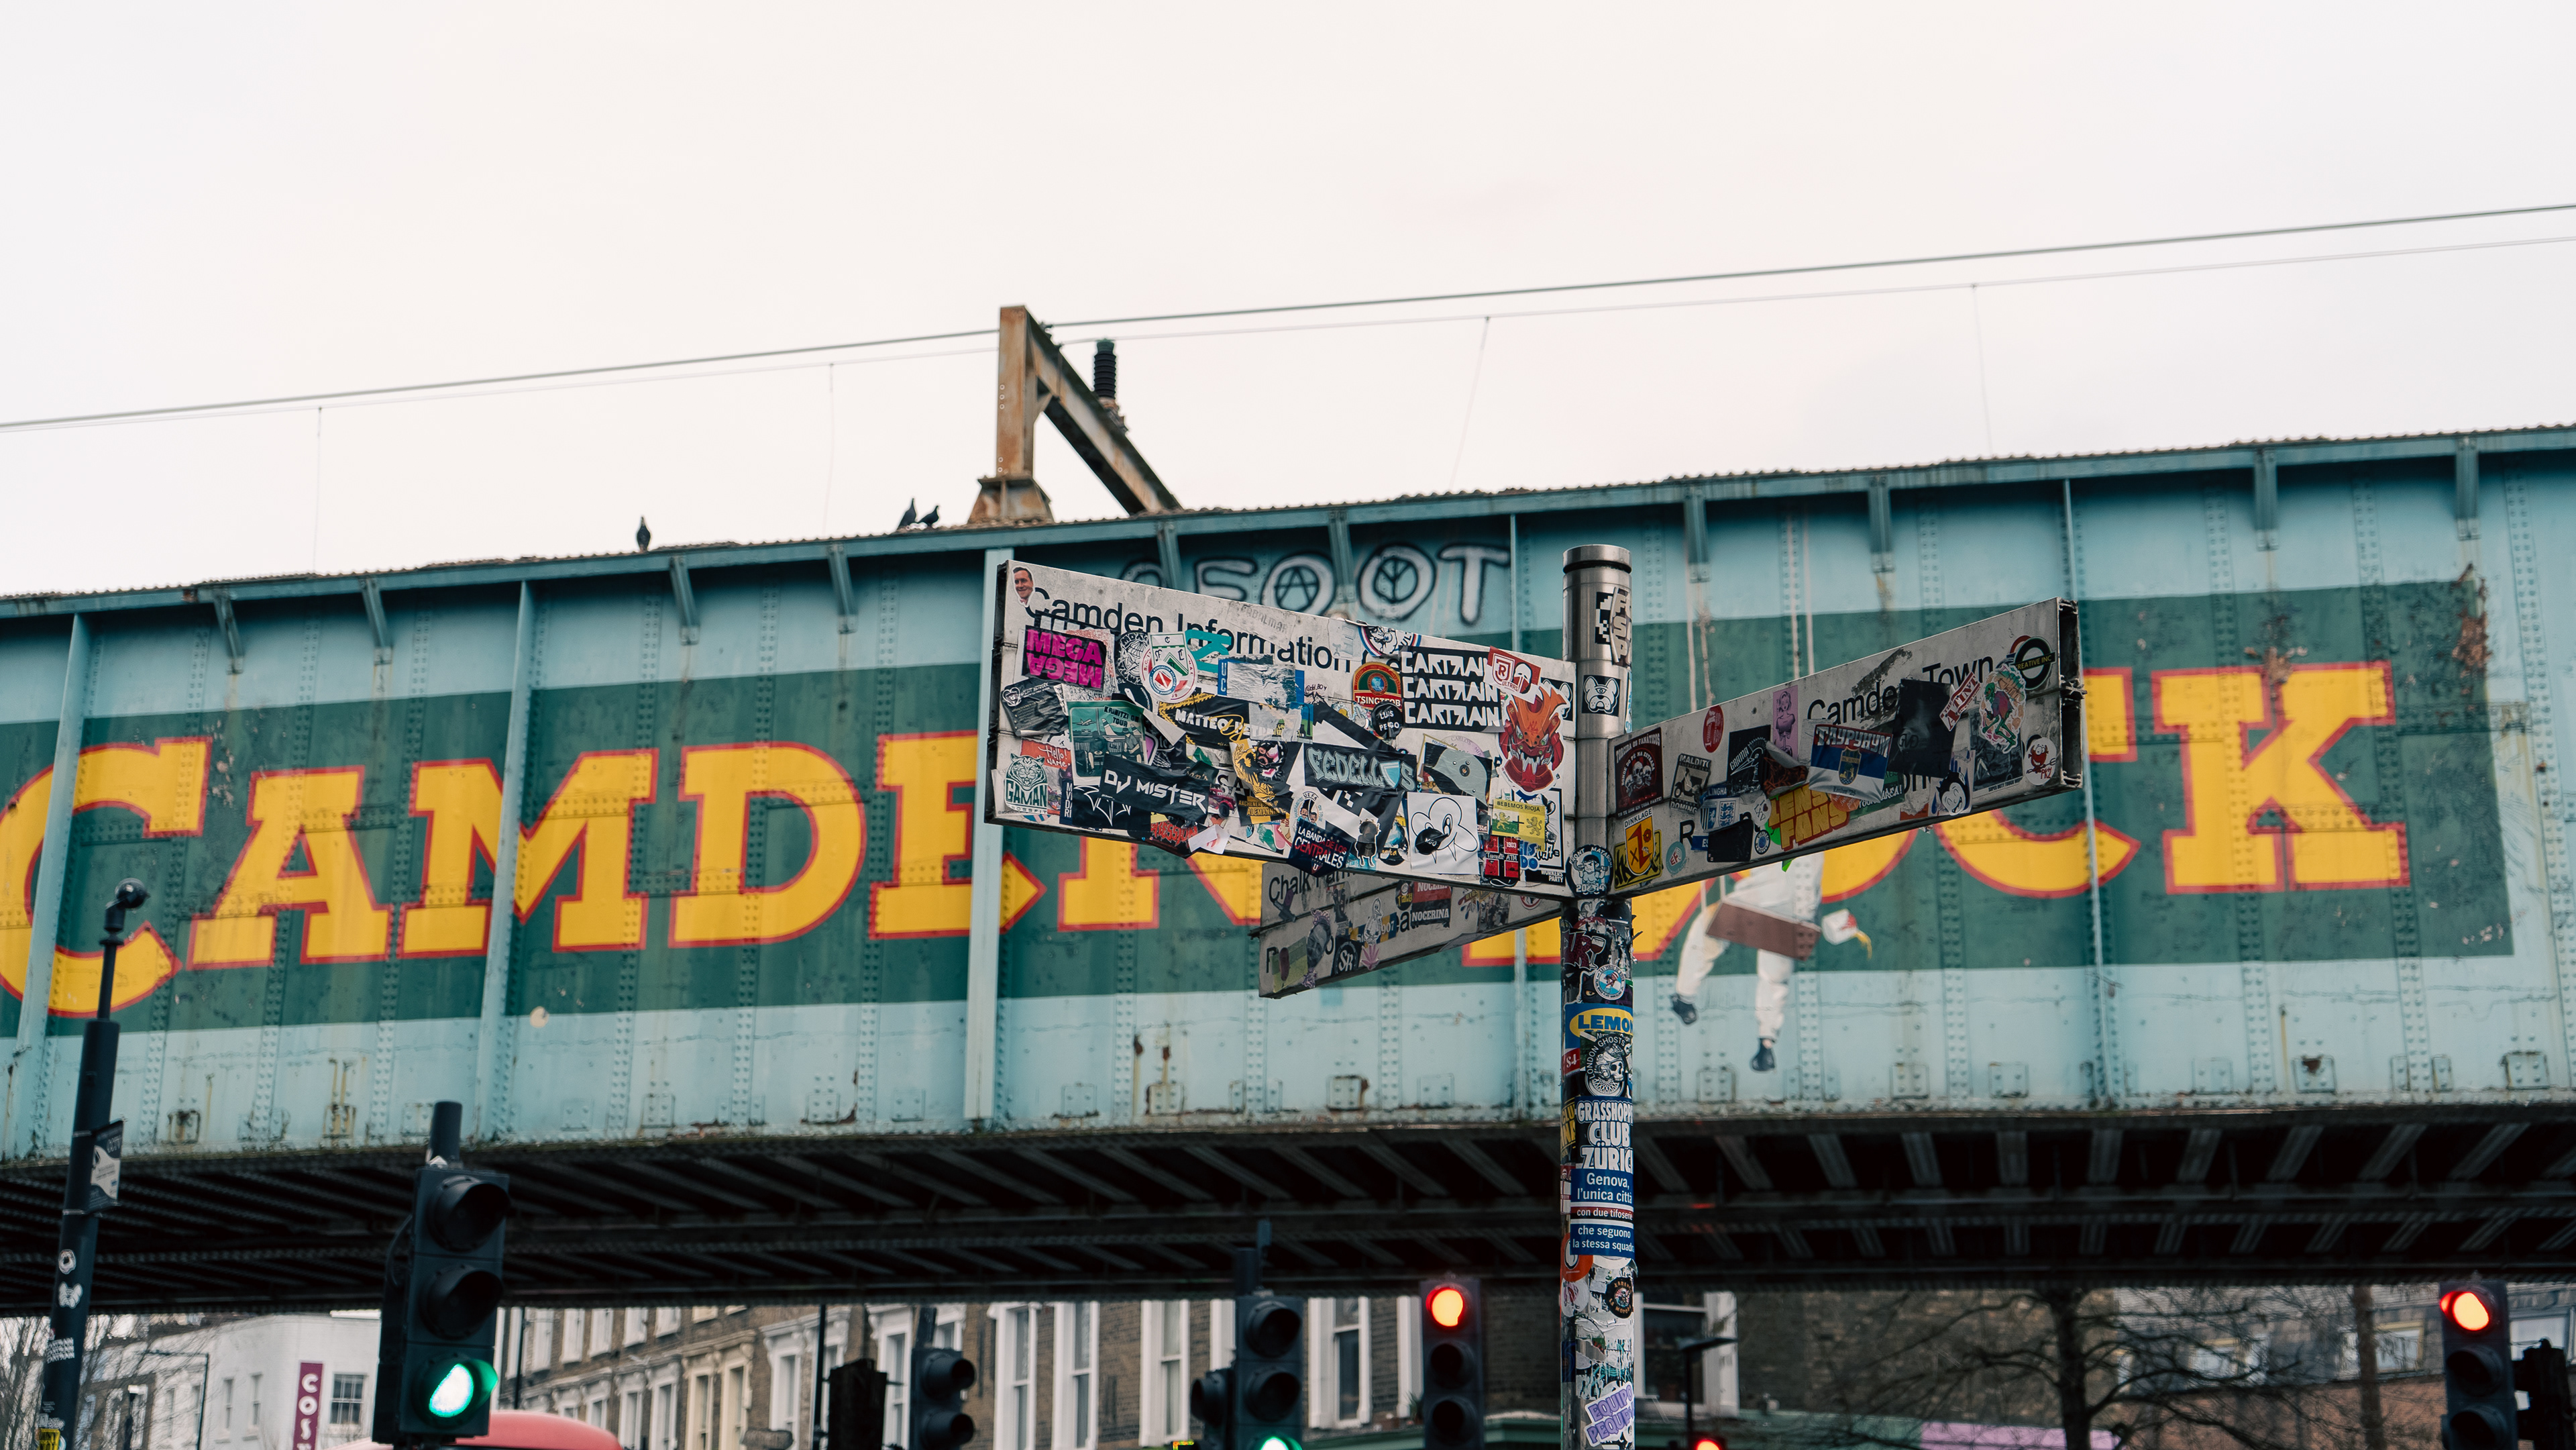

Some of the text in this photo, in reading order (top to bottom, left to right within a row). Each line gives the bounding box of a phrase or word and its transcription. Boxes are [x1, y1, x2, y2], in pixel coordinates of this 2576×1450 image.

[1026, 629, 1103, 666] MEGA
[1402, 676, 1499, 703] CARTRAIN
[1502, 680, 1519, 691] ULTRAS
[1807, 656, 1993, 725] Camde Town
[1113, 717, 1128, 727] TOUR
[1175, 709, 1230, 731] MATTEO
[1379, 711, 1394, 720] LUIS
[1404, 701, 1501, 727] CARTRAIN
[1038, 745, 1067, 760] Hello!
[1006, 780, 1047, 807] GAMAN
[1104, 770, 1207, 815] DJ MISTER
[1303, 792, 1318, 800] UEFA
[1497, 800, 1523, 809] BEBEMOS
[1464, 660, 2411, 966] CK
[1625, 808, 1652, 827] DINKLAGE
[1780, 802, 1848, 850] FANS
[1298, 826, 1347, 856] LA BANDA DE LOS
[1295, 837, 1344, 870] CENTRALES
[0, 730, 1265, 1019] CAMDE
[1313, 863, 1318, 871] U
[1548, 875, 1564, 883] PARTY
[1269, 869, 1309, 904] Chalk
[1412, 909, 1449, 922] NOCERINA
[1586, 1036, 1625, 1080] LONDON GHOSTS
[1589, 1121, 1630, 1147] CLUB
[1581, 1141, 1633, 1174] ZÜRIC
[1587, 1172, 1629, 1190] Genova,
[1577, 1188, 1613, 1201] l'unica
[1616, 1192, 1632, 1204] città
[1593, 1209, 1608, 1217] due
[1610, 1209, 1633, 1221] tifoserie
[1578, 1225, 1631, 1239] che seguono
[1572, 1239, 1634, 1253] la stessa squad
[1587, 1384, 1633, 1422] EQUIPO
